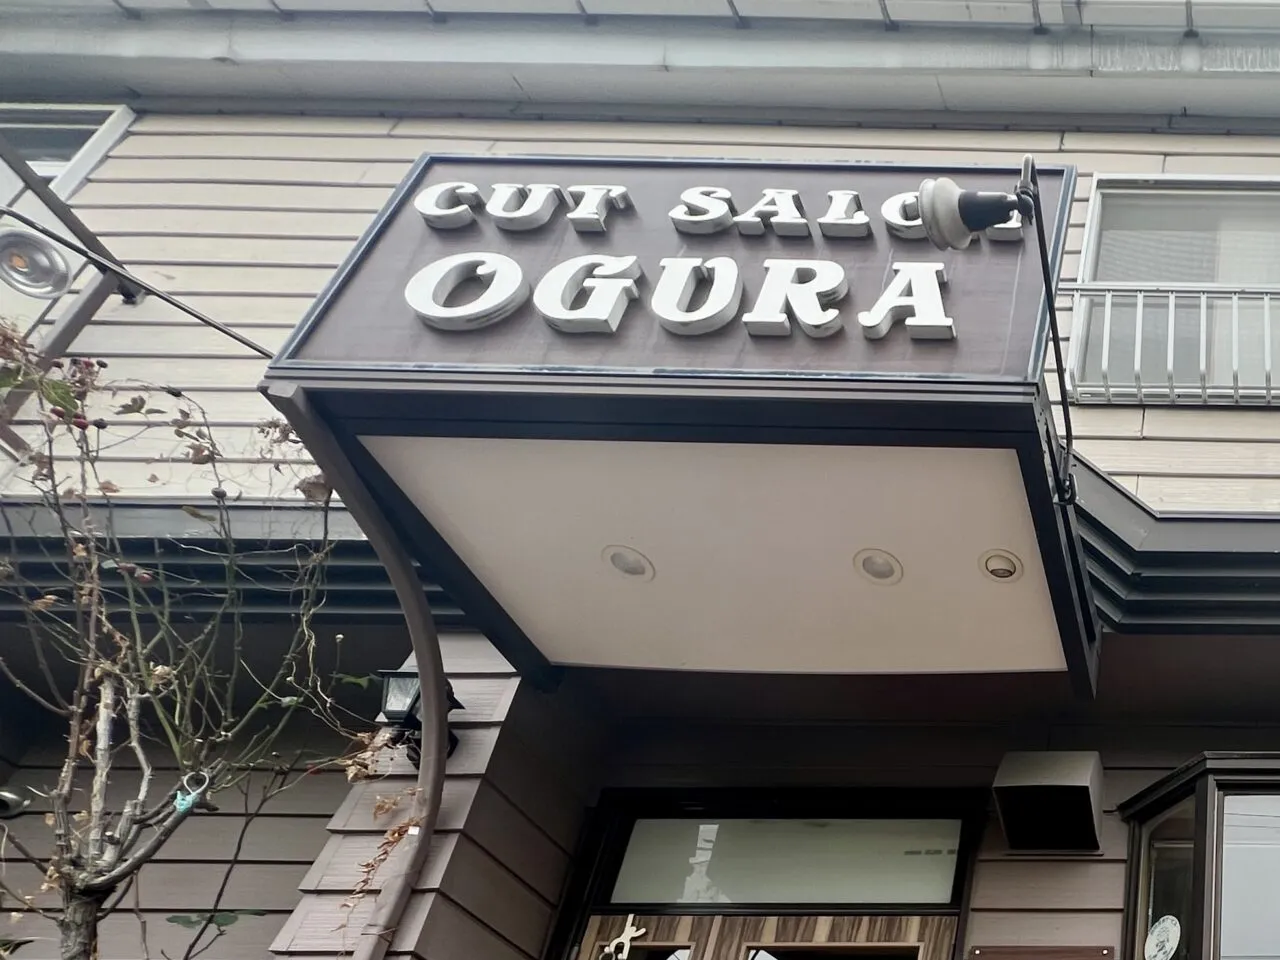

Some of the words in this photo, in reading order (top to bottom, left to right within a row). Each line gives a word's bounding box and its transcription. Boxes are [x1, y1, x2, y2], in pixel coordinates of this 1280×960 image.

[413, 182, 637, 232] CUT
[669, 187, 1023, 241] SALO
[404, 252, 957, 340] OGURA
